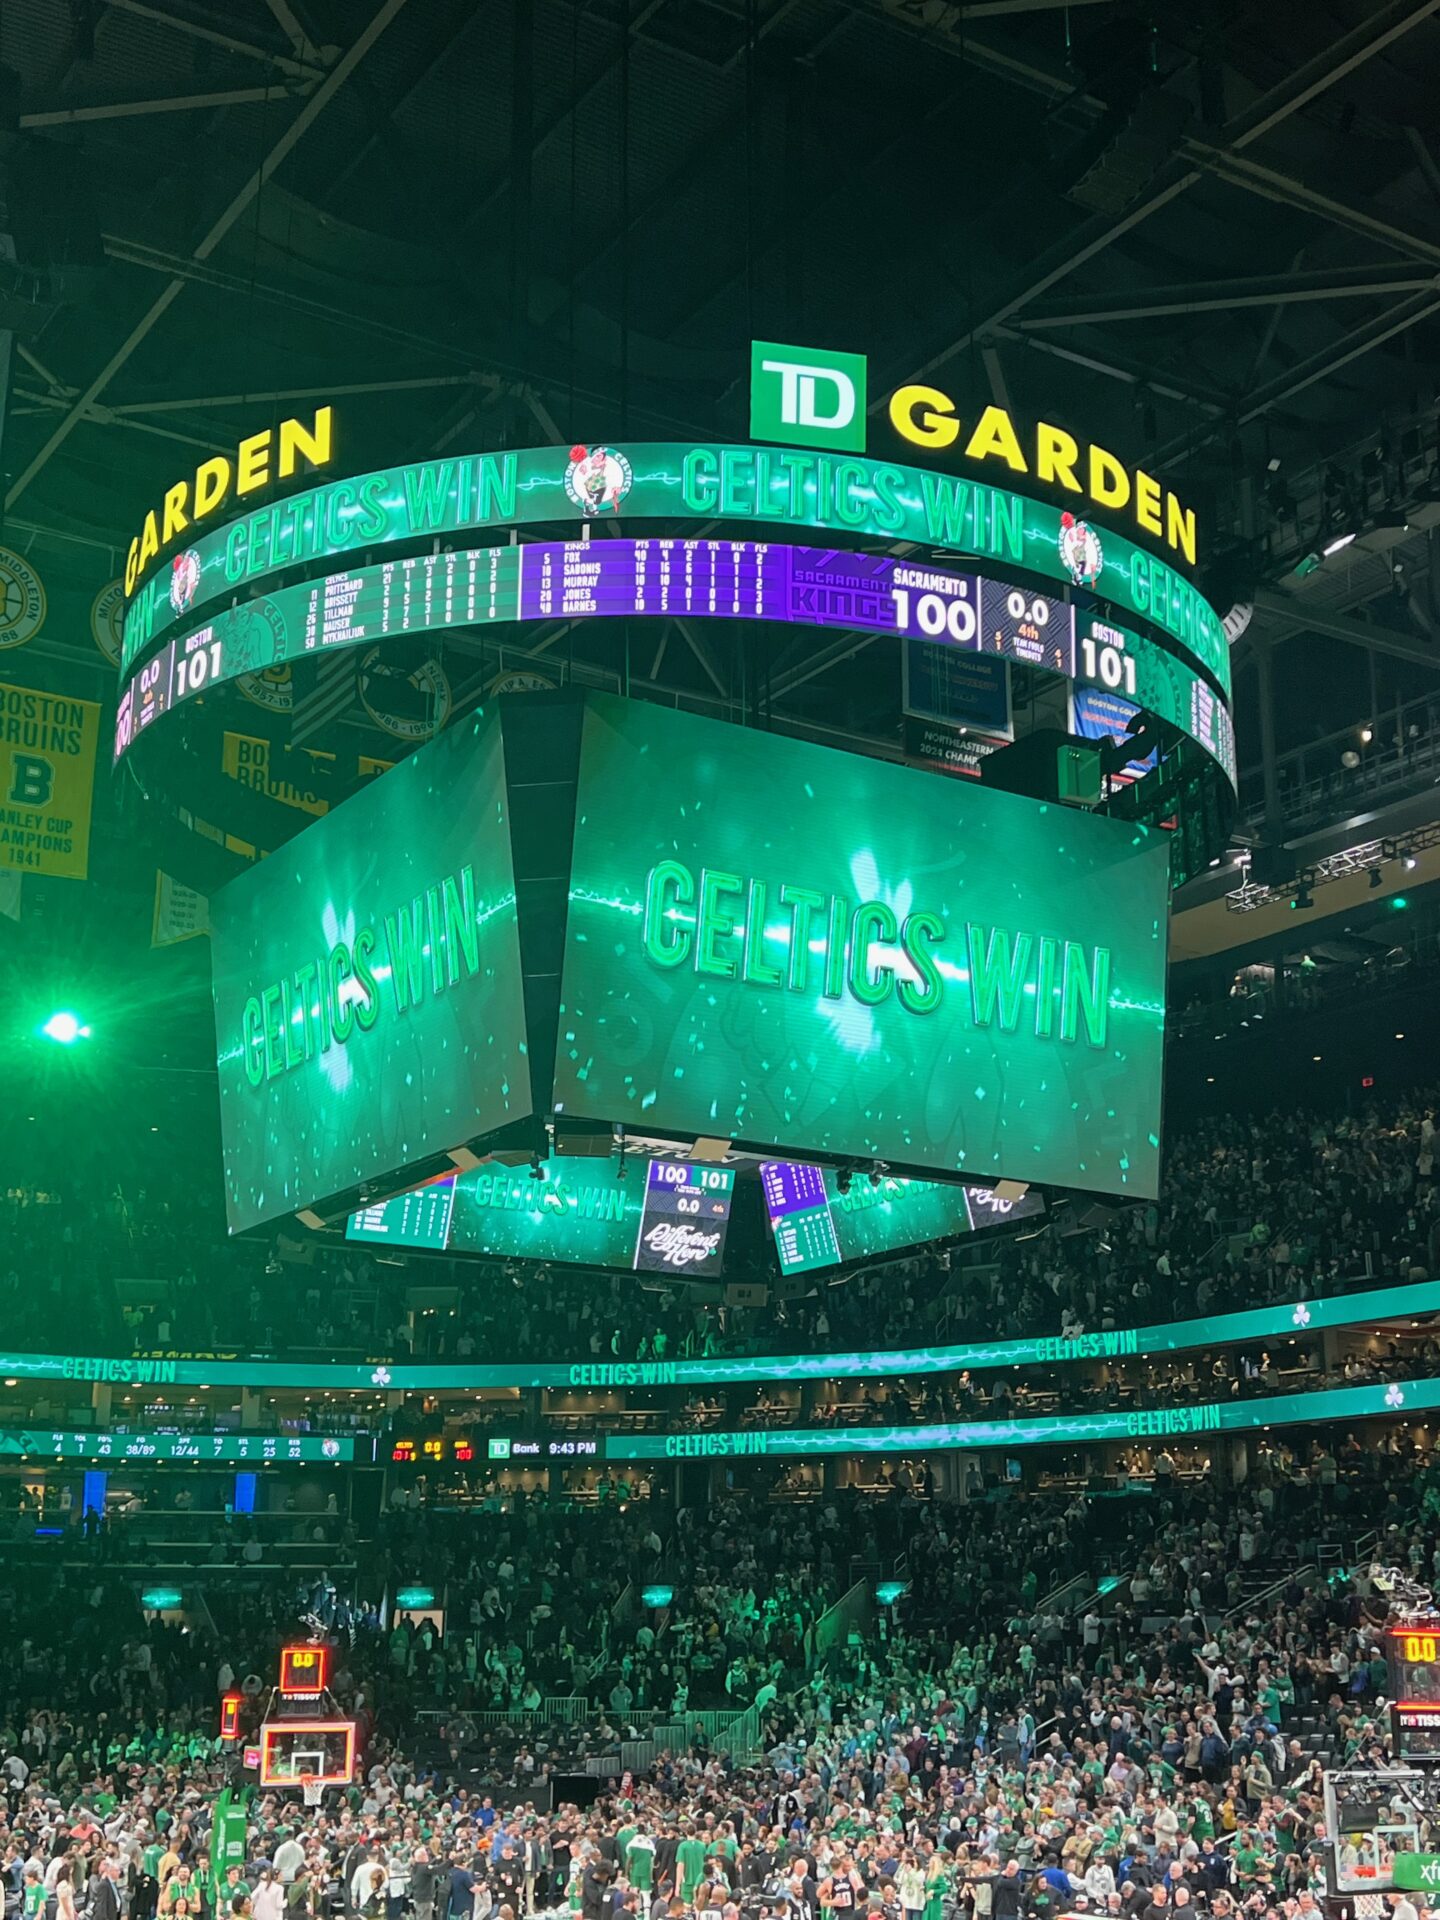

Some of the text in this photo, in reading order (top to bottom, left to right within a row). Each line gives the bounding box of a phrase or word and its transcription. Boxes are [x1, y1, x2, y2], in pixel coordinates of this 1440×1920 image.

[762, 360, 856, 430] TD
[889, 384, 1196, 566] GARDEN
[124, 406, 333, 598] GARDEN
[682, 446, 907, 530] CELTICS
[919, 472, 1025, 562] WIN
[224, 472, 389, 587] CELTICS
[403, 453, 518, 531] WIN
[893, 567, 967, 598] SACRAMENTO
[892, 589, 976, 641] 100
[1007, 592, 1049, 626] 0.0
[1130, 550, 1221, 669] CELTICS
[1017, 624, 1040, 640] 4th
[1091, 621, 1125, 650] BOSTON
[140, 659, 160, 693] 0.0
[177, 642, 222, 696] 101
[1082, 637, 1136, 695] 101
[0, 716, 81, 756] RUINS
[10, 753, 52, 806] B
[46, 816, 73, 835] CUP
[642, 859, 1112, 1050] CELTICS WIN
[242, 863, 480, 1088] CELTICS WIN
[657, 1165, 728, 1190] 100 101
[474, 1174, 570, 1216] CELTICS
[576, 1187, 628, 1223] WIN
[677, 1198, 700, 1214] 0.0
[1104, 1330, 1138, 1356] WIN
[62, 1357, 176, 1383] CELTICS WIN
[569, 1362, 676, 1386] CELTICS WIN
[1126, 1404, 1220, 1436] CELTICS WIN
[54, 1443, 300, 1458] 4 1 43 38/89 12/44 7 5 25 52
[491, 1442, 596, 1455] TD Bank 9:43 PM
[665, 1431, 767, 1457] CELTICS WIN
[1406, 1637, 1436, 1662] 0.0
